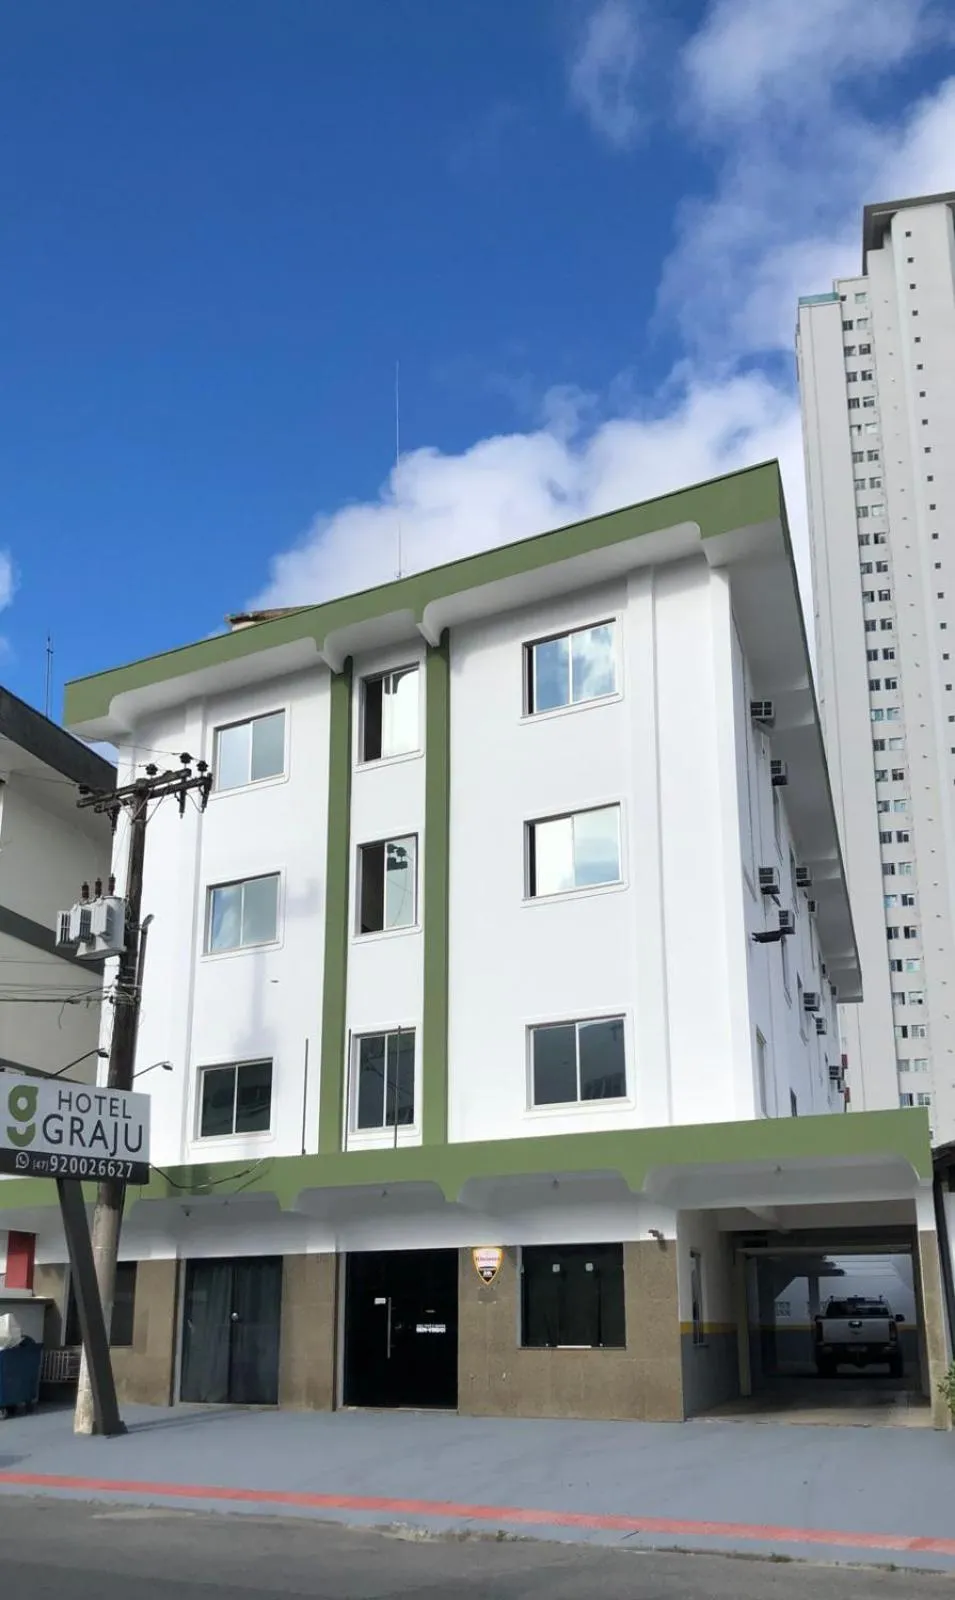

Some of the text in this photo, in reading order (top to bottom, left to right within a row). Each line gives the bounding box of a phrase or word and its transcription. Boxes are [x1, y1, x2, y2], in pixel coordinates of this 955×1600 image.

[58, 1089, 132, 1120] HOTEL
[42, 1113, 143, 1157] GRAJU
[49, 1155, 133, 1178] 920026627
